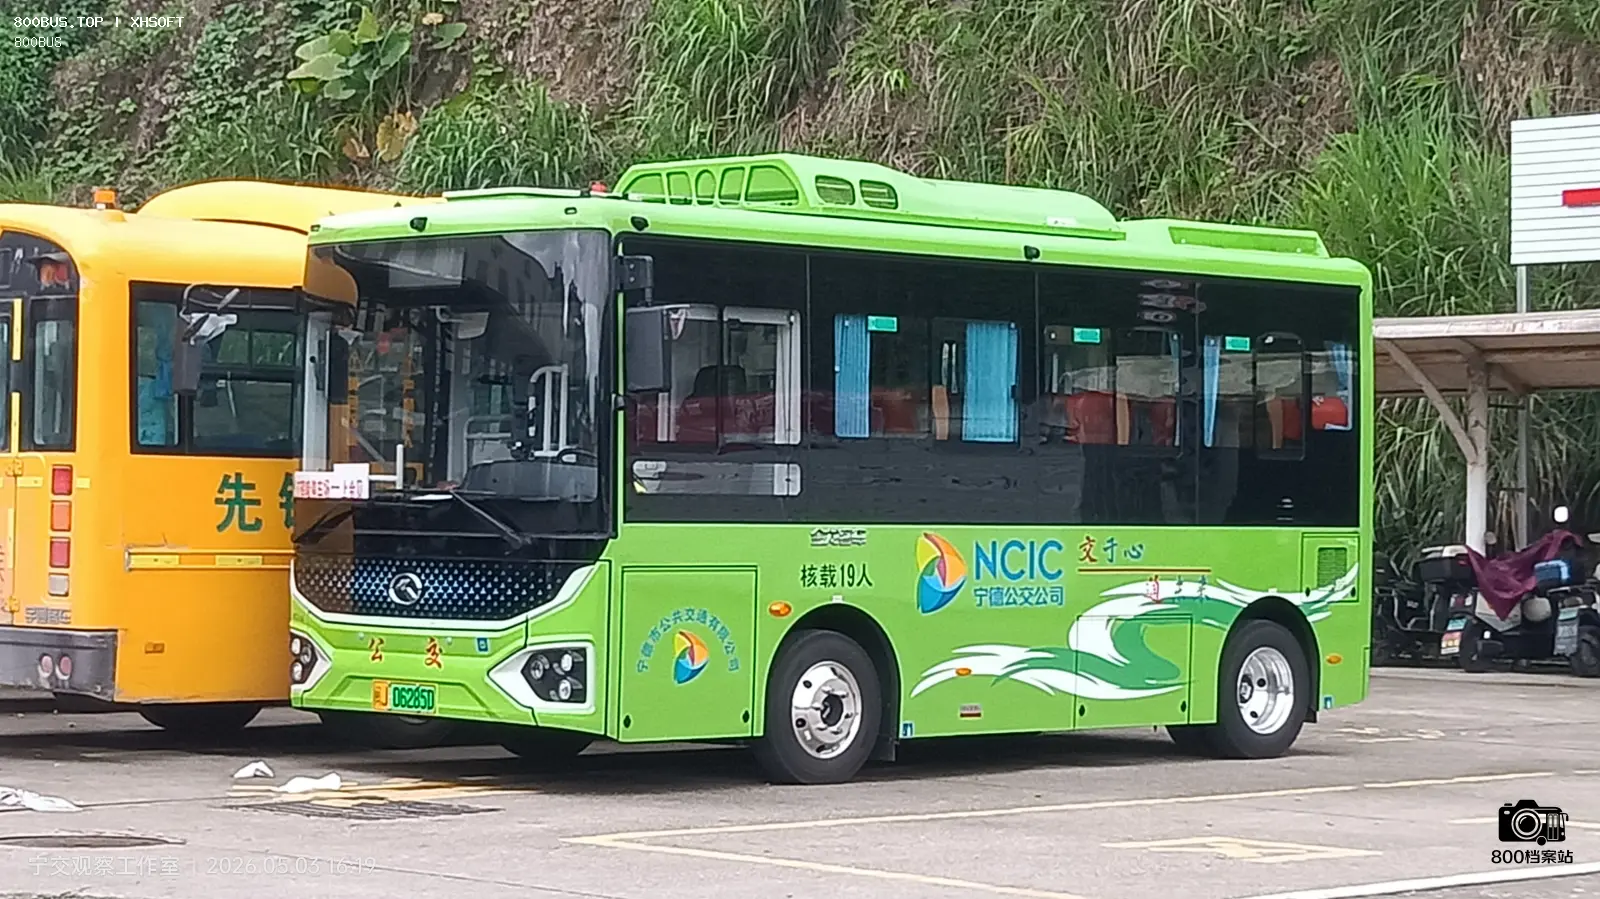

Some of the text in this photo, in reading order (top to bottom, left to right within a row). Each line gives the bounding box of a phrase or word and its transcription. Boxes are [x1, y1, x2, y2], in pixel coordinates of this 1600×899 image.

[974, 540, 1063, 580] NCIC
[800, 563, 873, 588] 核载19人
[974, 586, 1063, 607] 宁德公交公司
